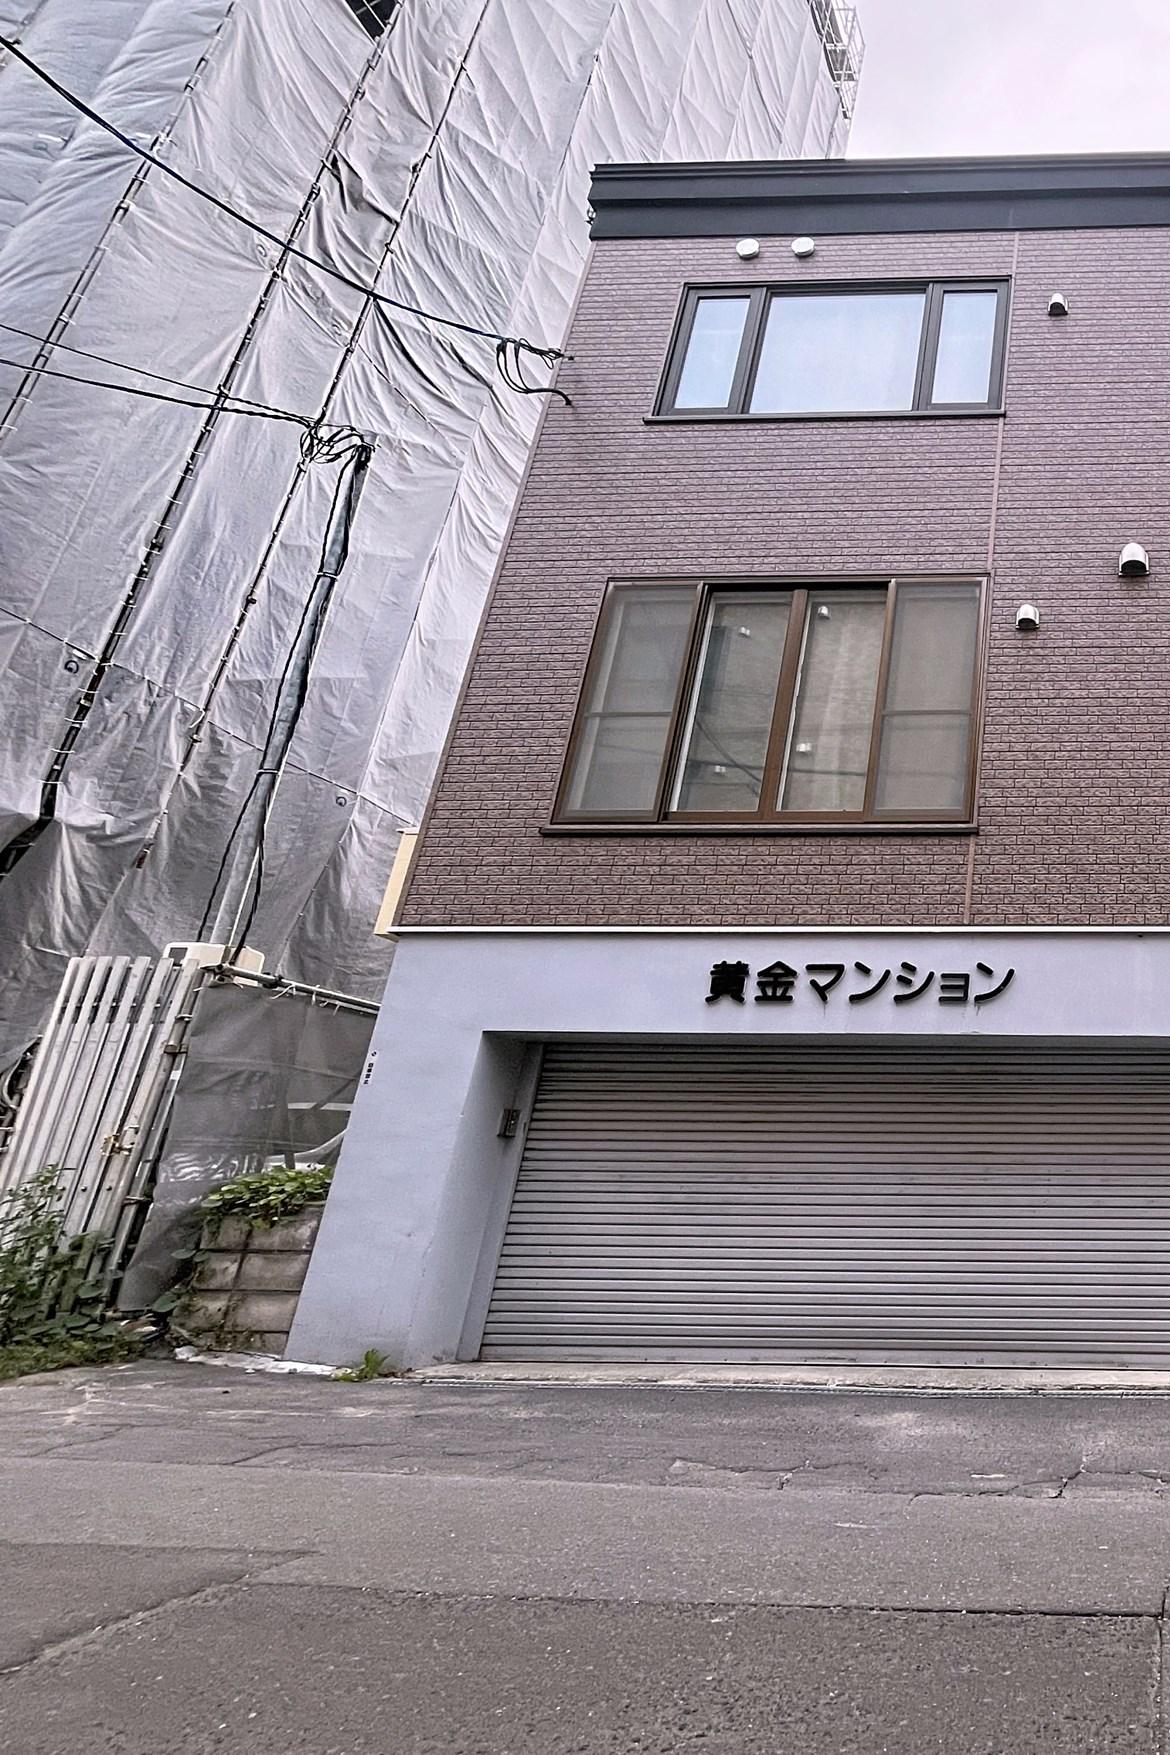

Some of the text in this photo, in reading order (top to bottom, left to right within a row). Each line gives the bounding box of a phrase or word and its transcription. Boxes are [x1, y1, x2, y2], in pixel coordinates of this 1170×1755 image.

[705, 961, 1015, 1004] 黄金マンション
